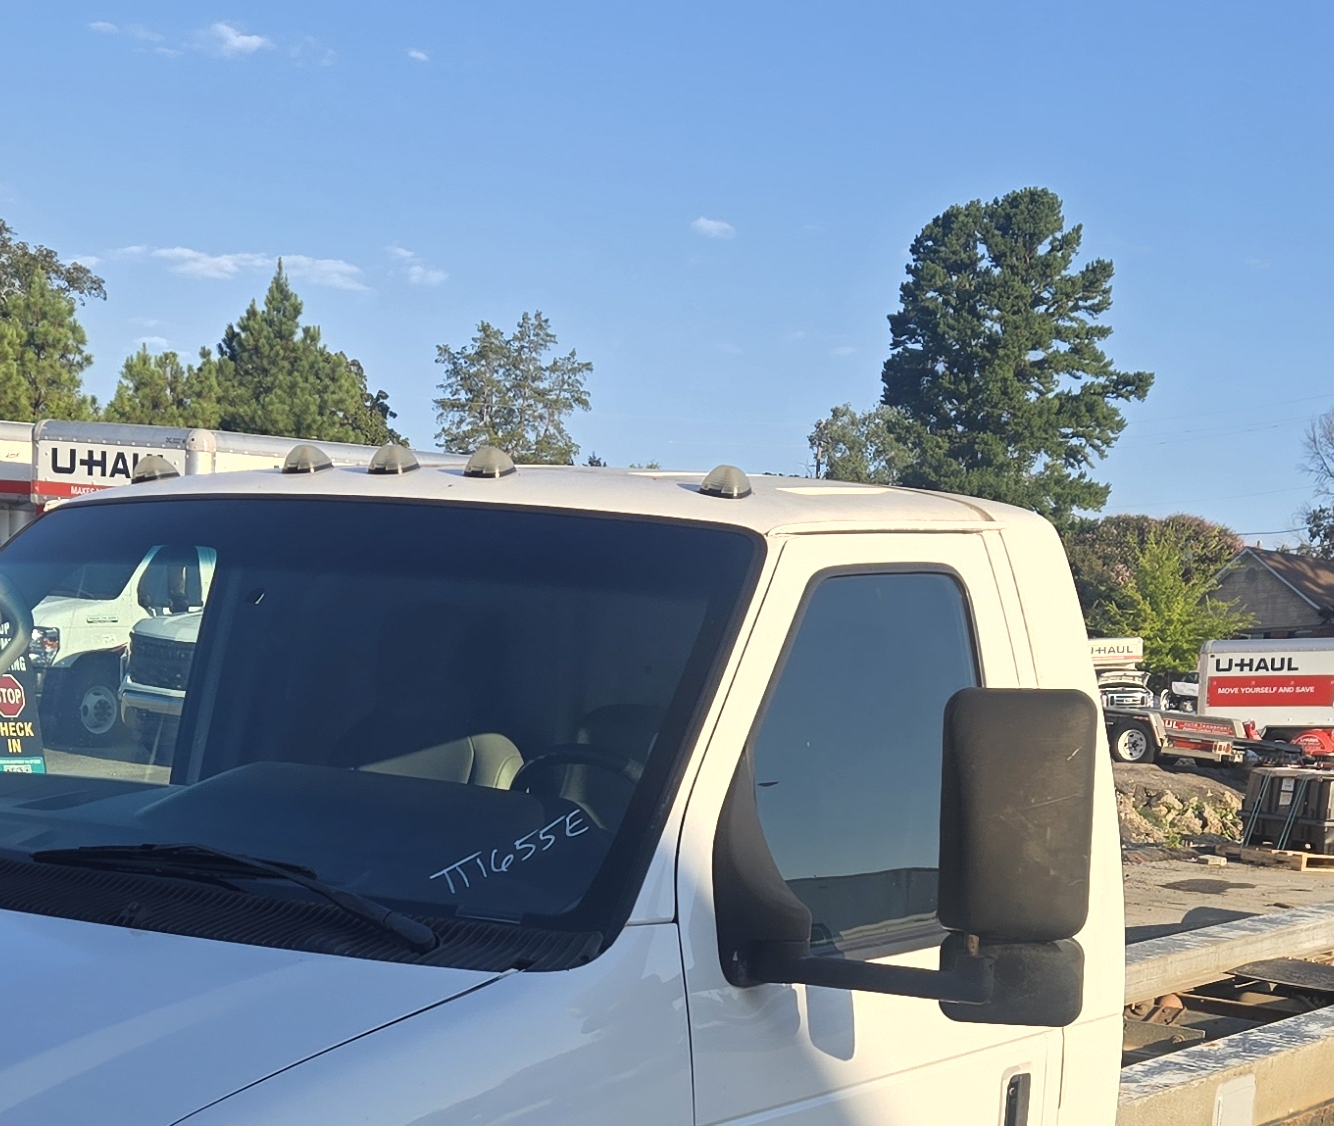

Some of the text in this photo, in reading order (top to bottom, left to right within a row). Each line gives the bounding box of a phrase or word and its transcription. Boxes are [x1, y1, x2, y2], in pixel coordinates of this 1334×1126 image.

[1216, 657, 1299, 672] U-HAUL
[1240, 686, 1277, 694] YOURSELF
[7, 738, 22, 753] IN
